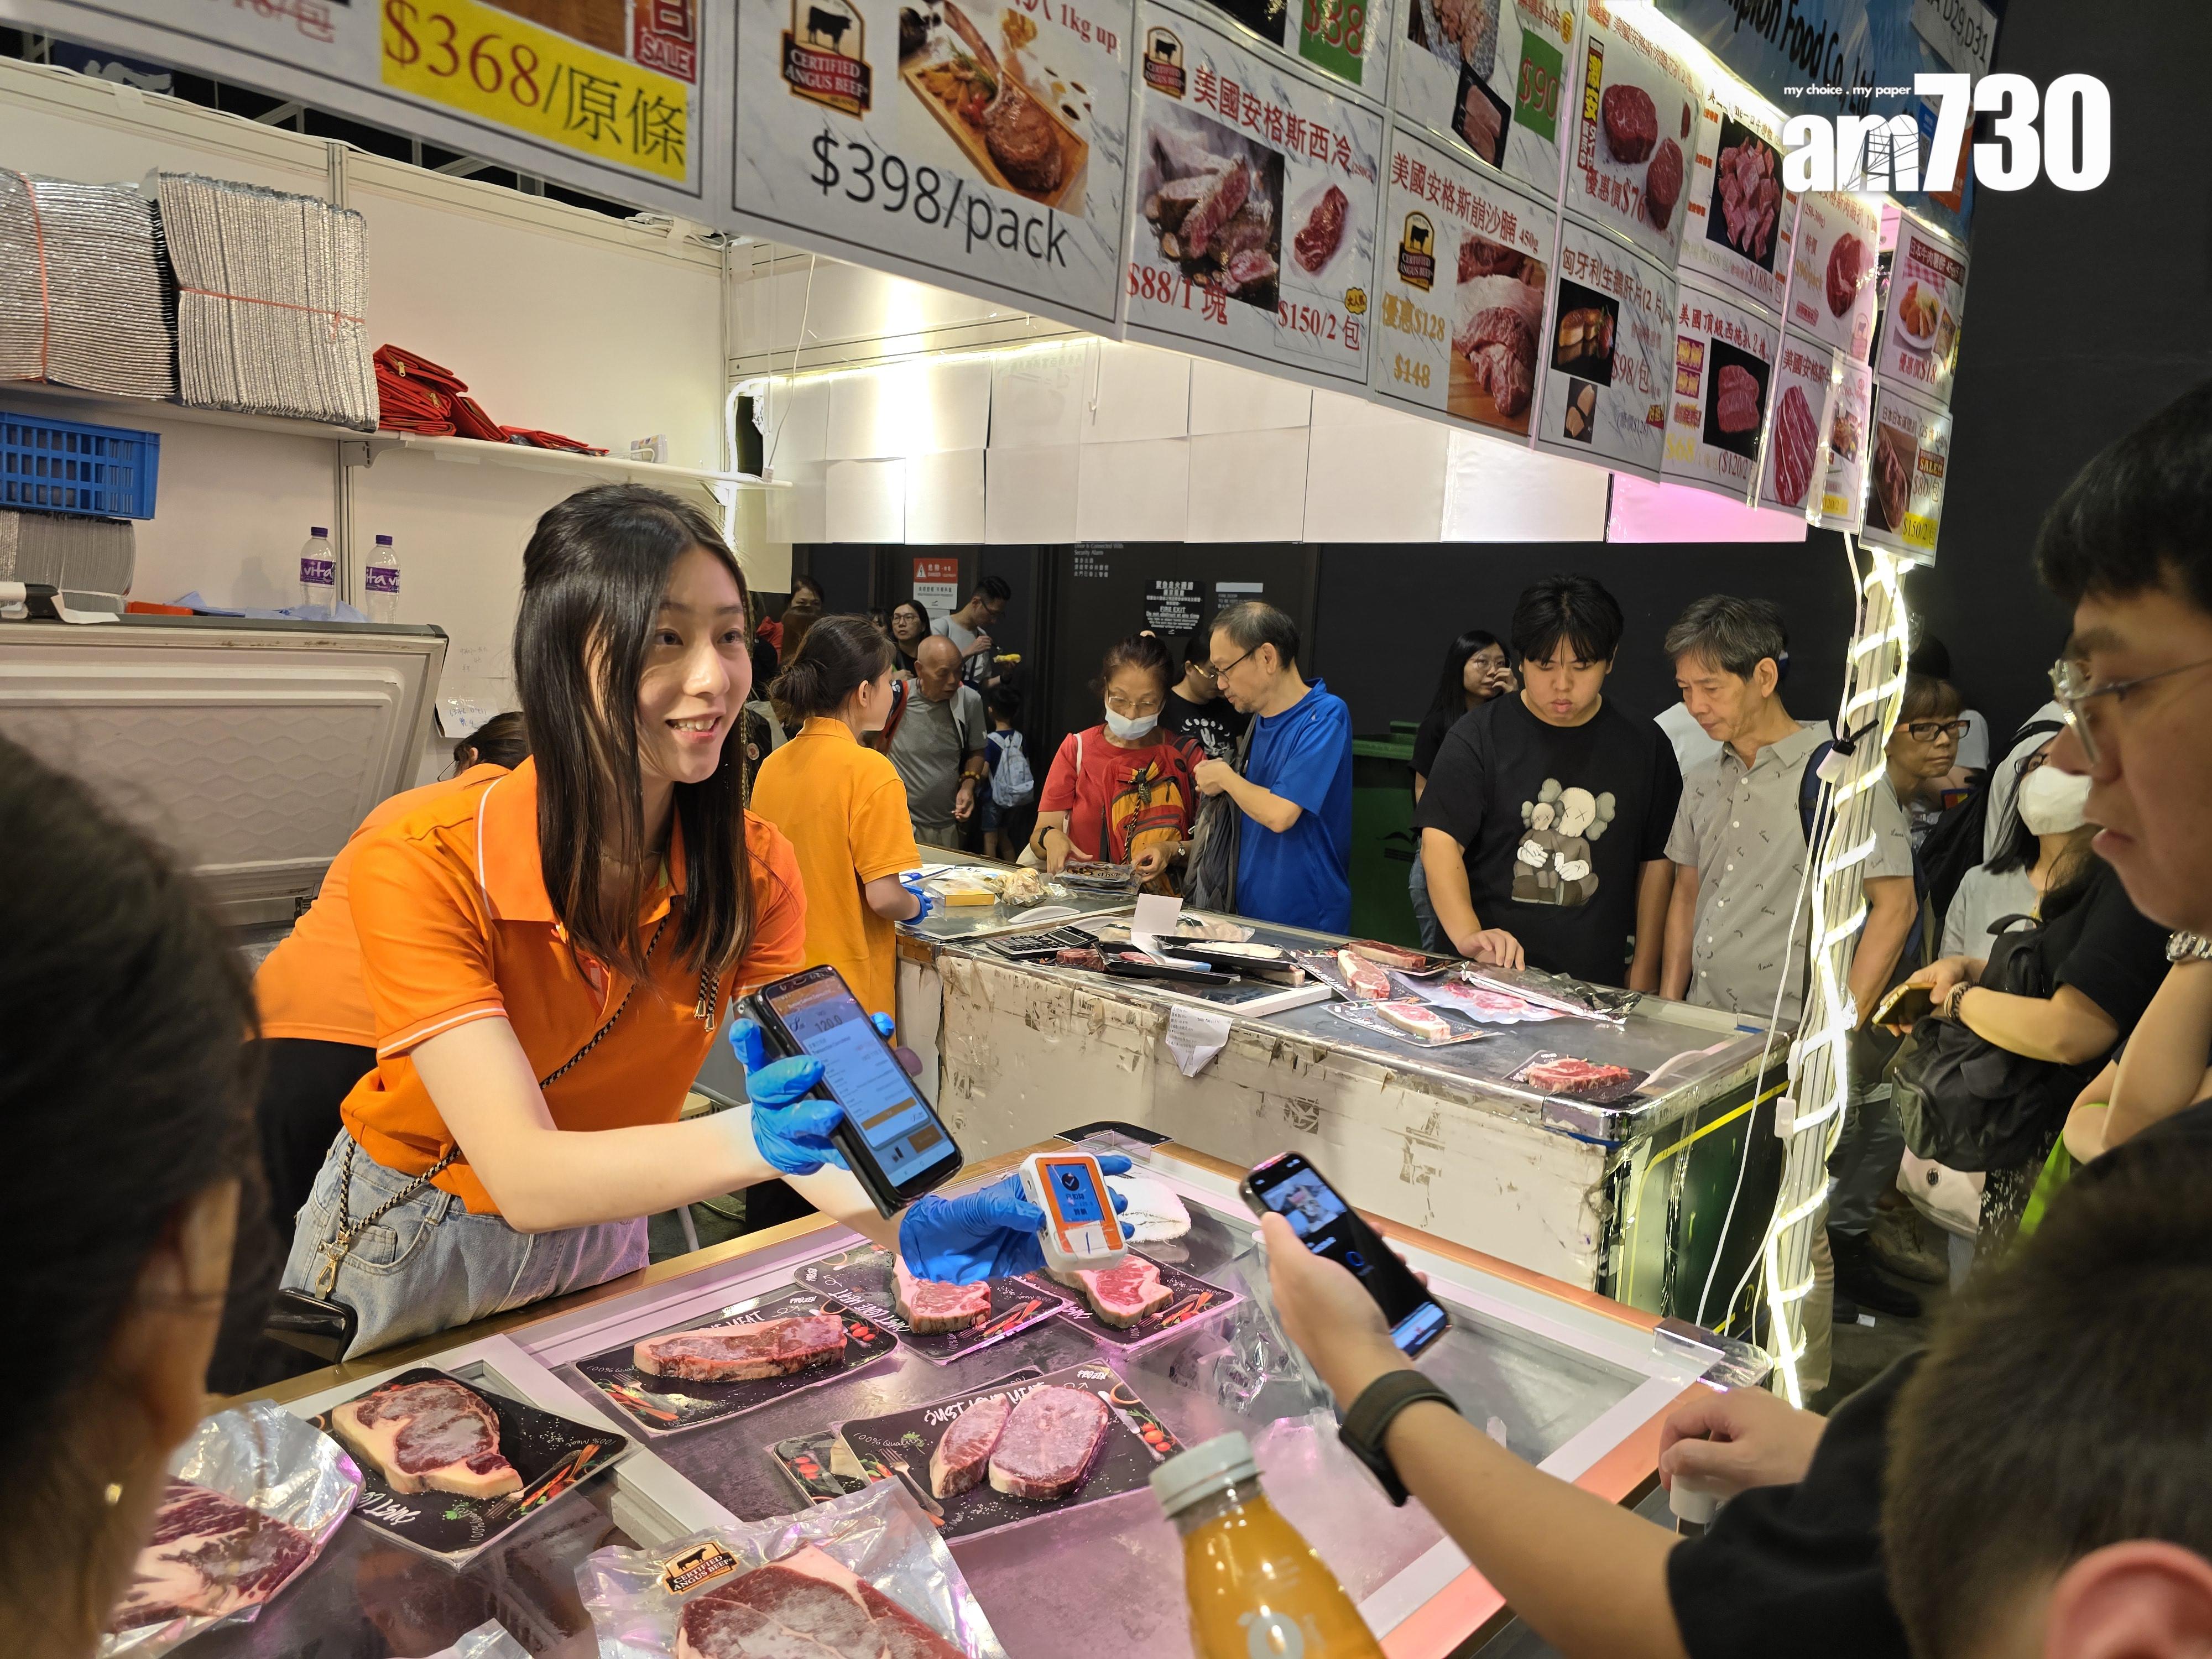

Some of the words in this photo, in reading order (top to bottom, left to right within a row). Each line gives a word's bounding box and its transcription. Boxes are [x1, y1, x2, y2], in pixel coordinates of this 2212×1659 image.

[1061, 4, 1092, 43] 1kg
[1096, 25, 1118, 55] up
[1779, 0, 1827, 80] Food
[641, 33, 692, 79] SALE
[785, 64, 832, 90] ANGUS
[790, 49, 860, 78] CERTIFIED
[384, 0, 686, 166] $368/原條
[1518, 56, 1560, 122] $90
[1193, 65, 1352, 171] 美國安格斯西冷
[811, 129, 1067, 268] $398/pack
[1125, 262, 1192, 310] $88/1
[1201, 280, 1228, 325] 塊
[1278, 299, 1337, 340] $150/2
[1342, 315, 1360, 351] 包
[1394, 351, 1431, 389] $148
[304, 561, 333, 578] vita
[673, 1556, 723, 1584] CERTIFIED
[674, 1570, 708, 1590] ANGUS
